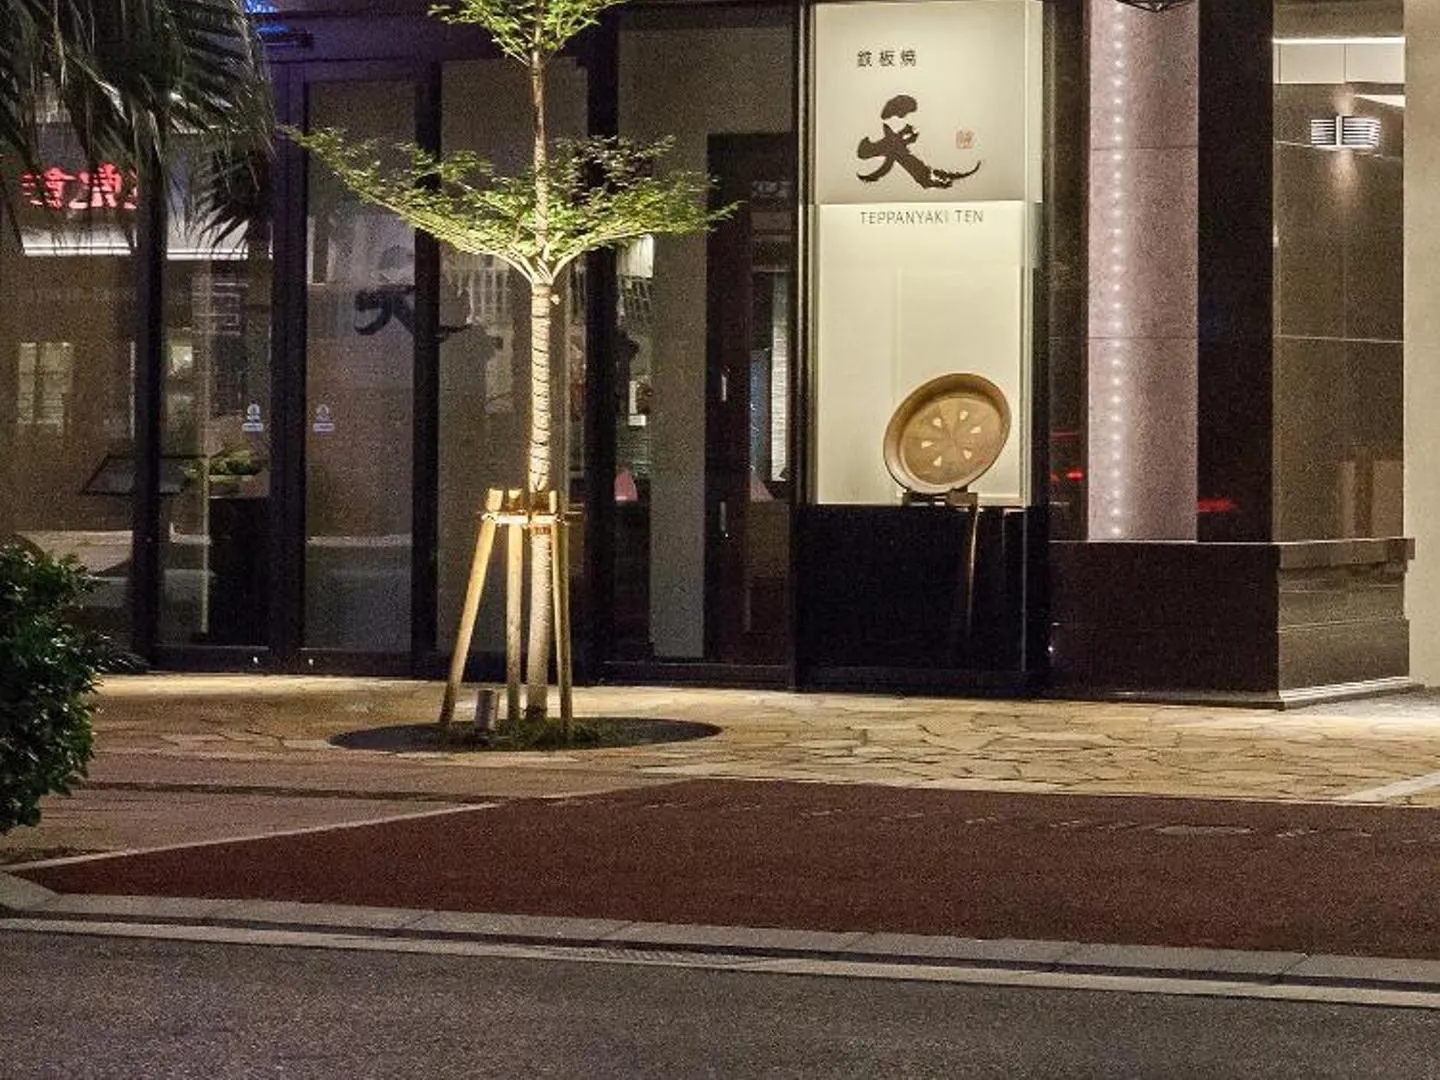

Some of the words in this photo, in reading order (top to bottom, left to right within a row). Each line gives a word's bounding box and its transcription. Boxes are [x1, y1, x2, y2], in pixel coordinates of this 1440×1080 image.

[857, 50, 917, 67] 鉄板焼
[856, 95, 982, 189] 天
[860, 210, 949, 224] TEPPANYAKI
[955, 209, 984, 224] TEN
